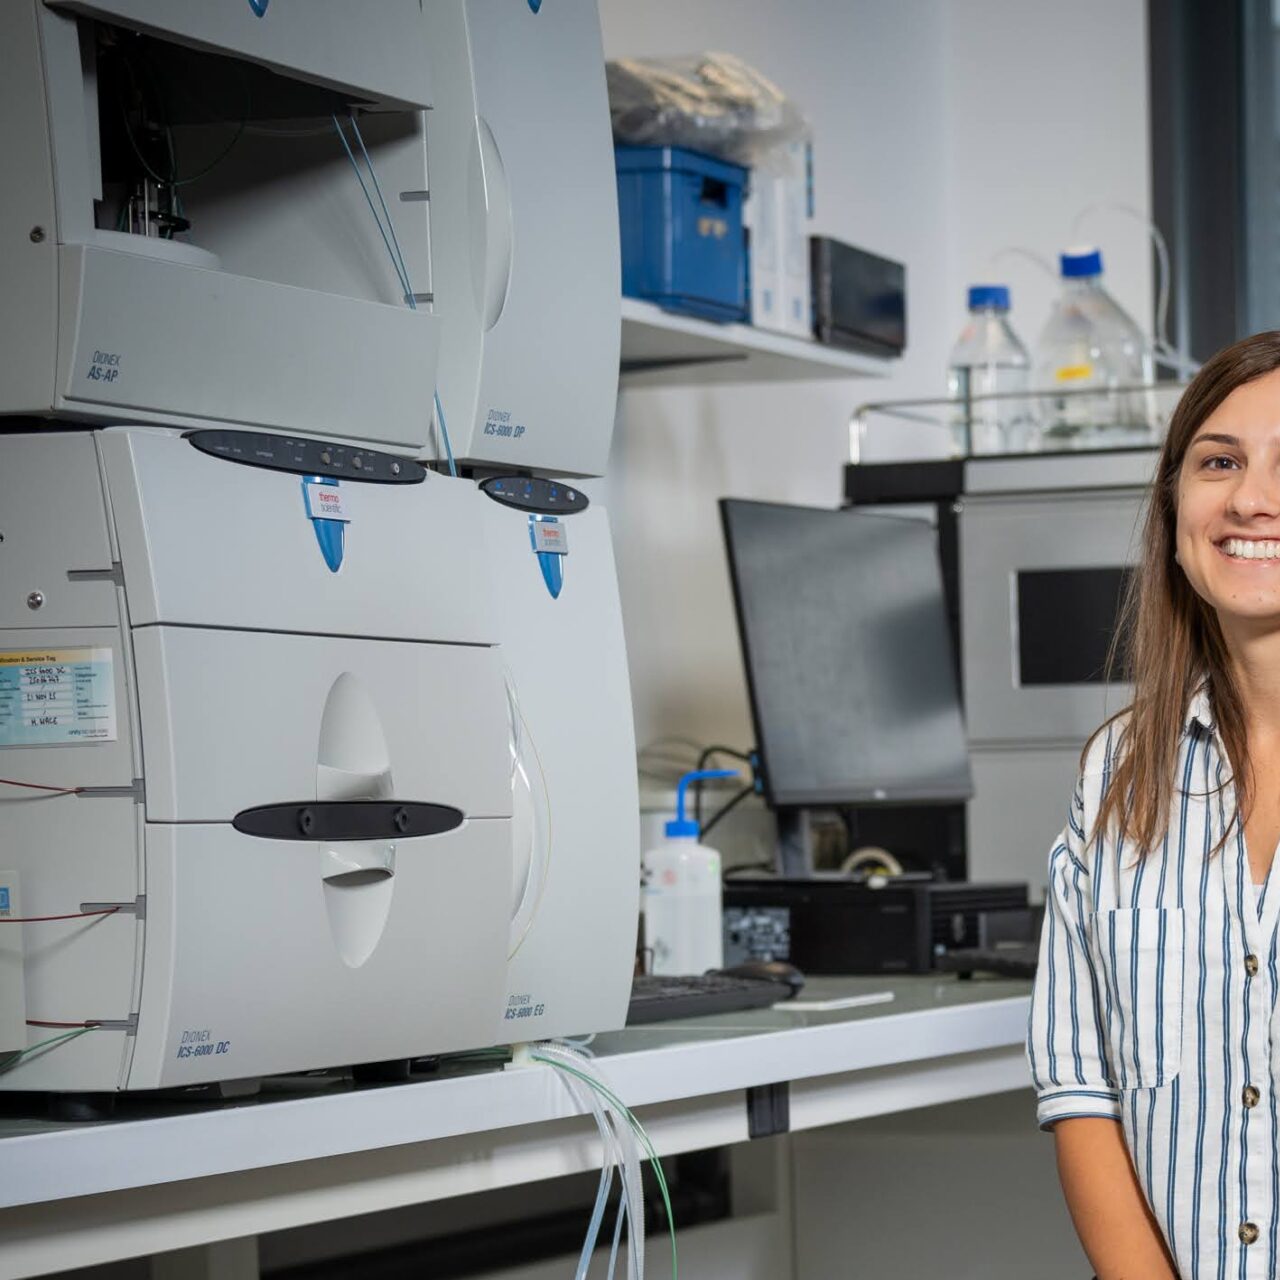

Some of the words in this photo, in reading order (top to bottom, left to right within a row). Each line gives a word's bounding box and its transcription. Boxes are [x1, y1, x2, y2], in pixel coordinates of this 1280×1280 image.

[87, 366, 118, 381] AS-AP
[514, 426, 525, 437] DP
[181, 1031, 210, 1043] DIONEX
[177, 1045, 214, 1058] ICS-6000
[216, 1041, 230, 1054] DC
